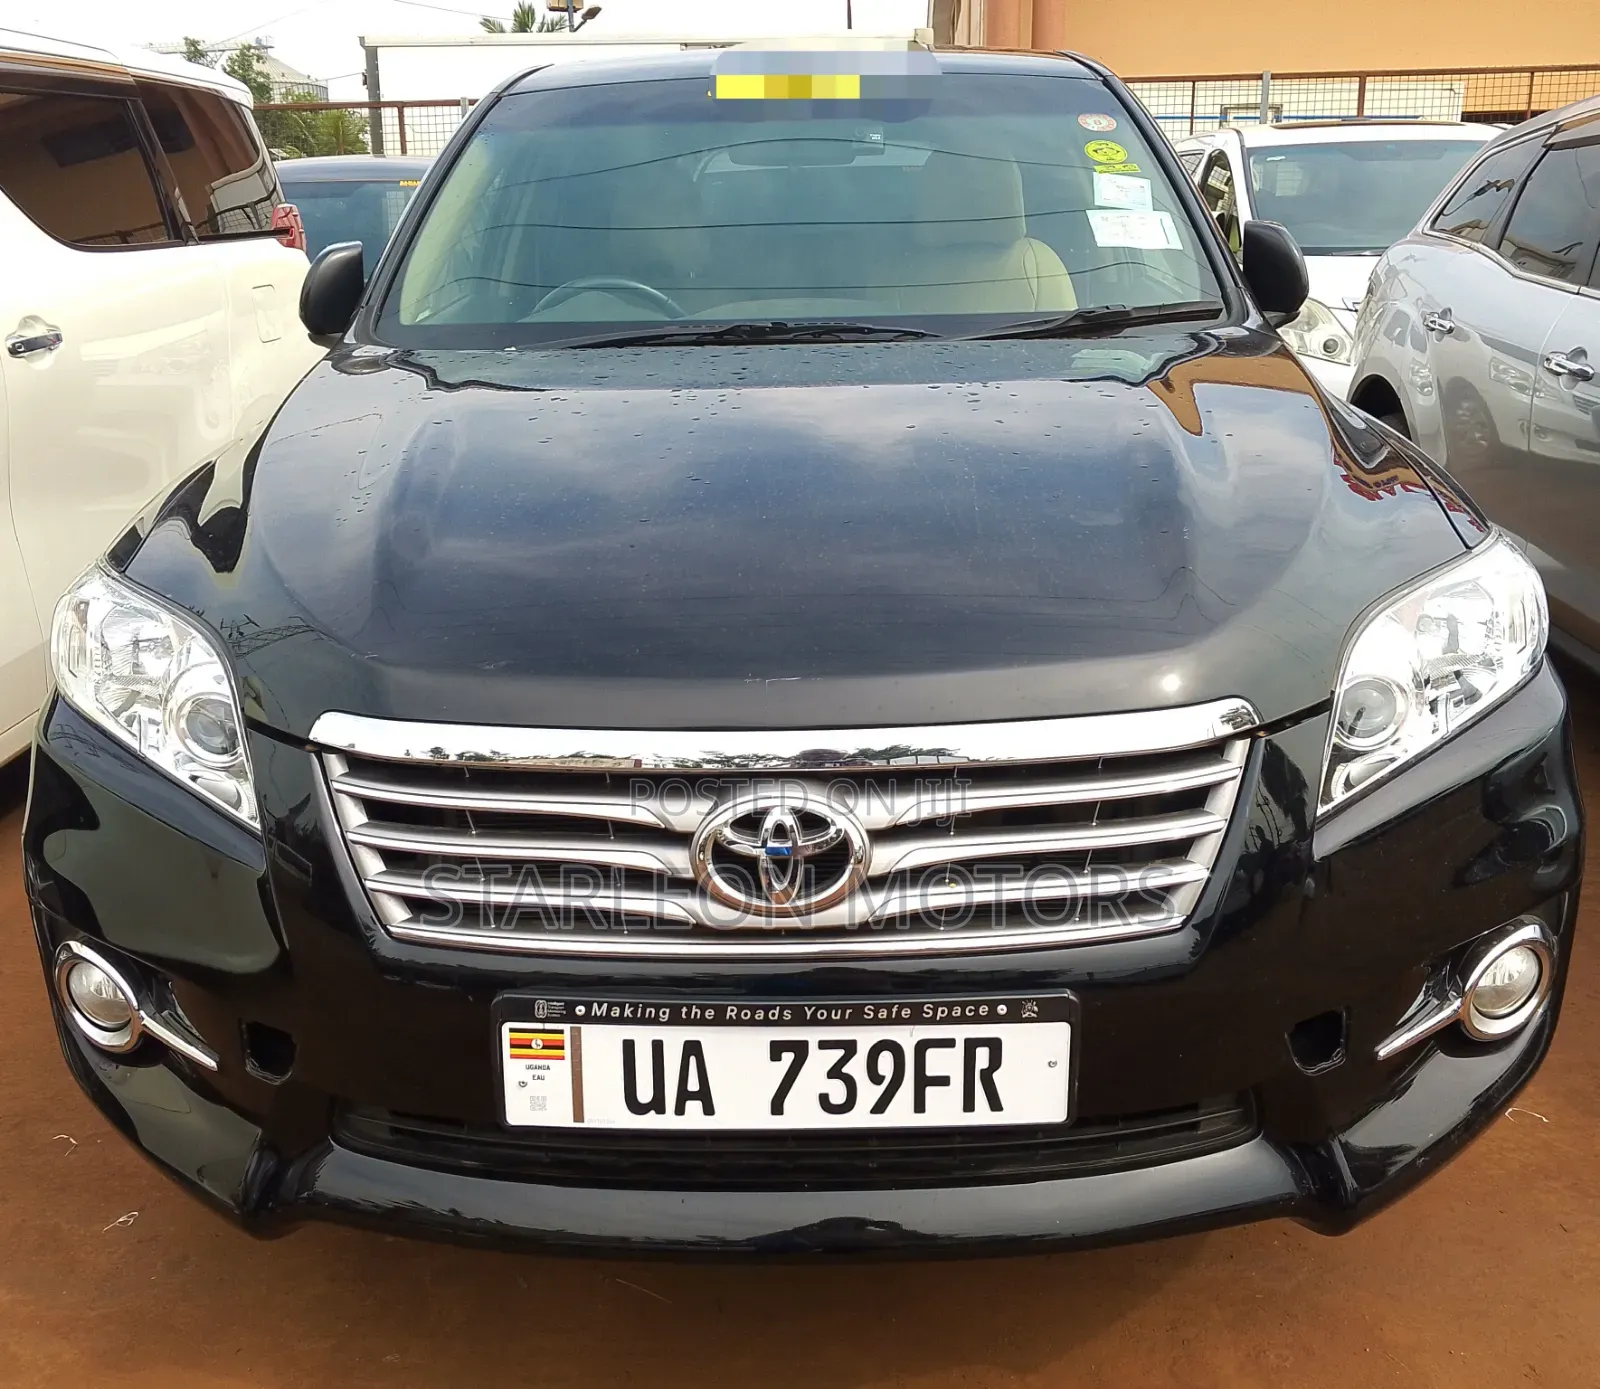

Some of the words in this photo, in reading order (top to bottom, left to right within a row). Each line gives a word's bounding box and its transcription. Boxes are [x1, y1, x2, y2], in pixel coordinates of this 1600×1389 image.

[590, 1002, 671, 1022] Making
[681, 1005, 716, 1020] the
[725, 1006, 793, 1021] Roads
[804, 1005, 853, 1020] Your
[863, 1003, 912, 1020] Safe
[922, 1002, 990, 1021] Space
[525, 1063, 551, 1071] UGANDA
[622, 1038, 716, 1117] UA
[769, 1036, 1005, 1116] 739FR
